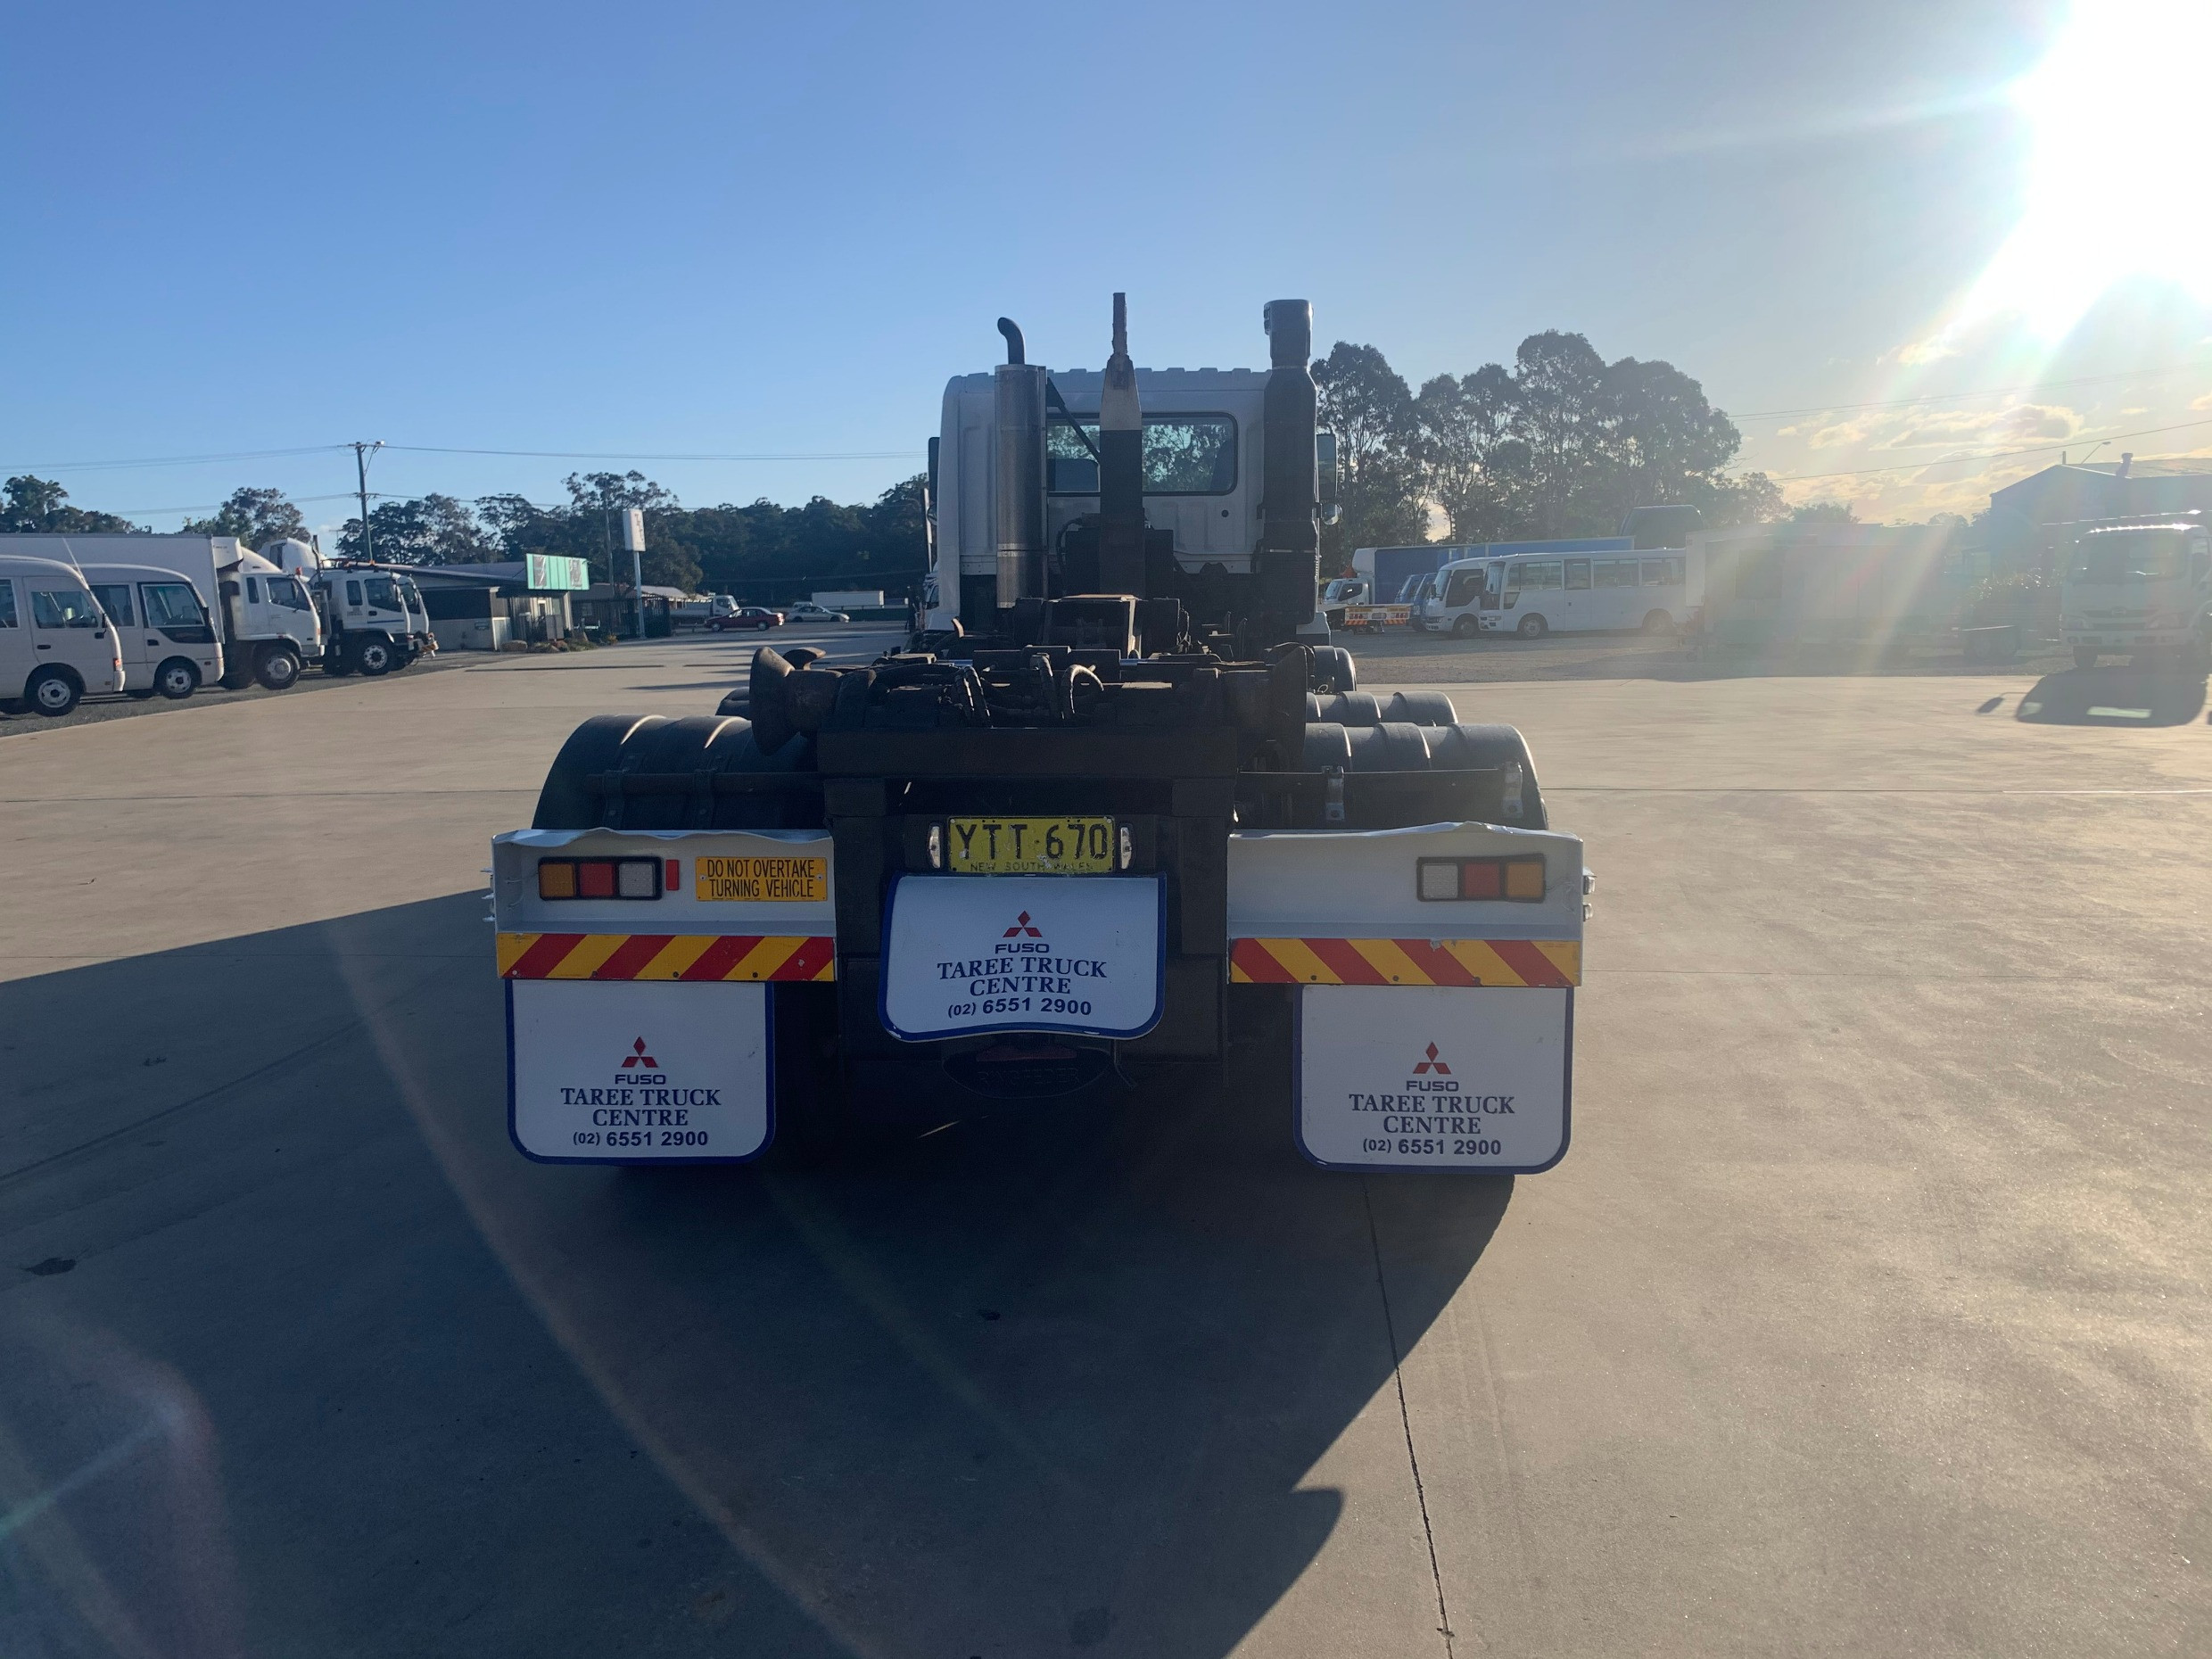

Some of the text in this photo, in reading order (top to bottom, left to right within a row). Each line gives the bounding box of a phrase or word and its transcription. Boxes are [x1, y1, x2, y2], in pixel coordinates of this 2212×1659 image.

[707, 859, 815, 878] DO NOT OVERTAKE
[970, 862, 1094, 872] NEW SOUTH WALES
[709, 879, 814, 897] TURNING VEHICLE
[995, 943, 1050, 954] FUSO
[937, 956, 1108, 980] TAREE TRUCK
[970, 976, 1071, 996] CENTRE
[947, 997, 1092, 1019] (02) 6551 2900
[615, 1074, 666, 1085] FUSO
[1406, 1080, 1459, 1092] FUSO
[560, 1087, 722, 1106] TAREE TRUCK
[1348, 1094, 1515, 1114] TAREE TRUCK
[592, 1109, 689, 1127] CENTRE
[1383, 1116, 1482, 1135] CENTRE
[573, 1131, 708, 1146] (02) 6551 2900
[1363, 1138, 1502, 1155] (02) 6551 2900
